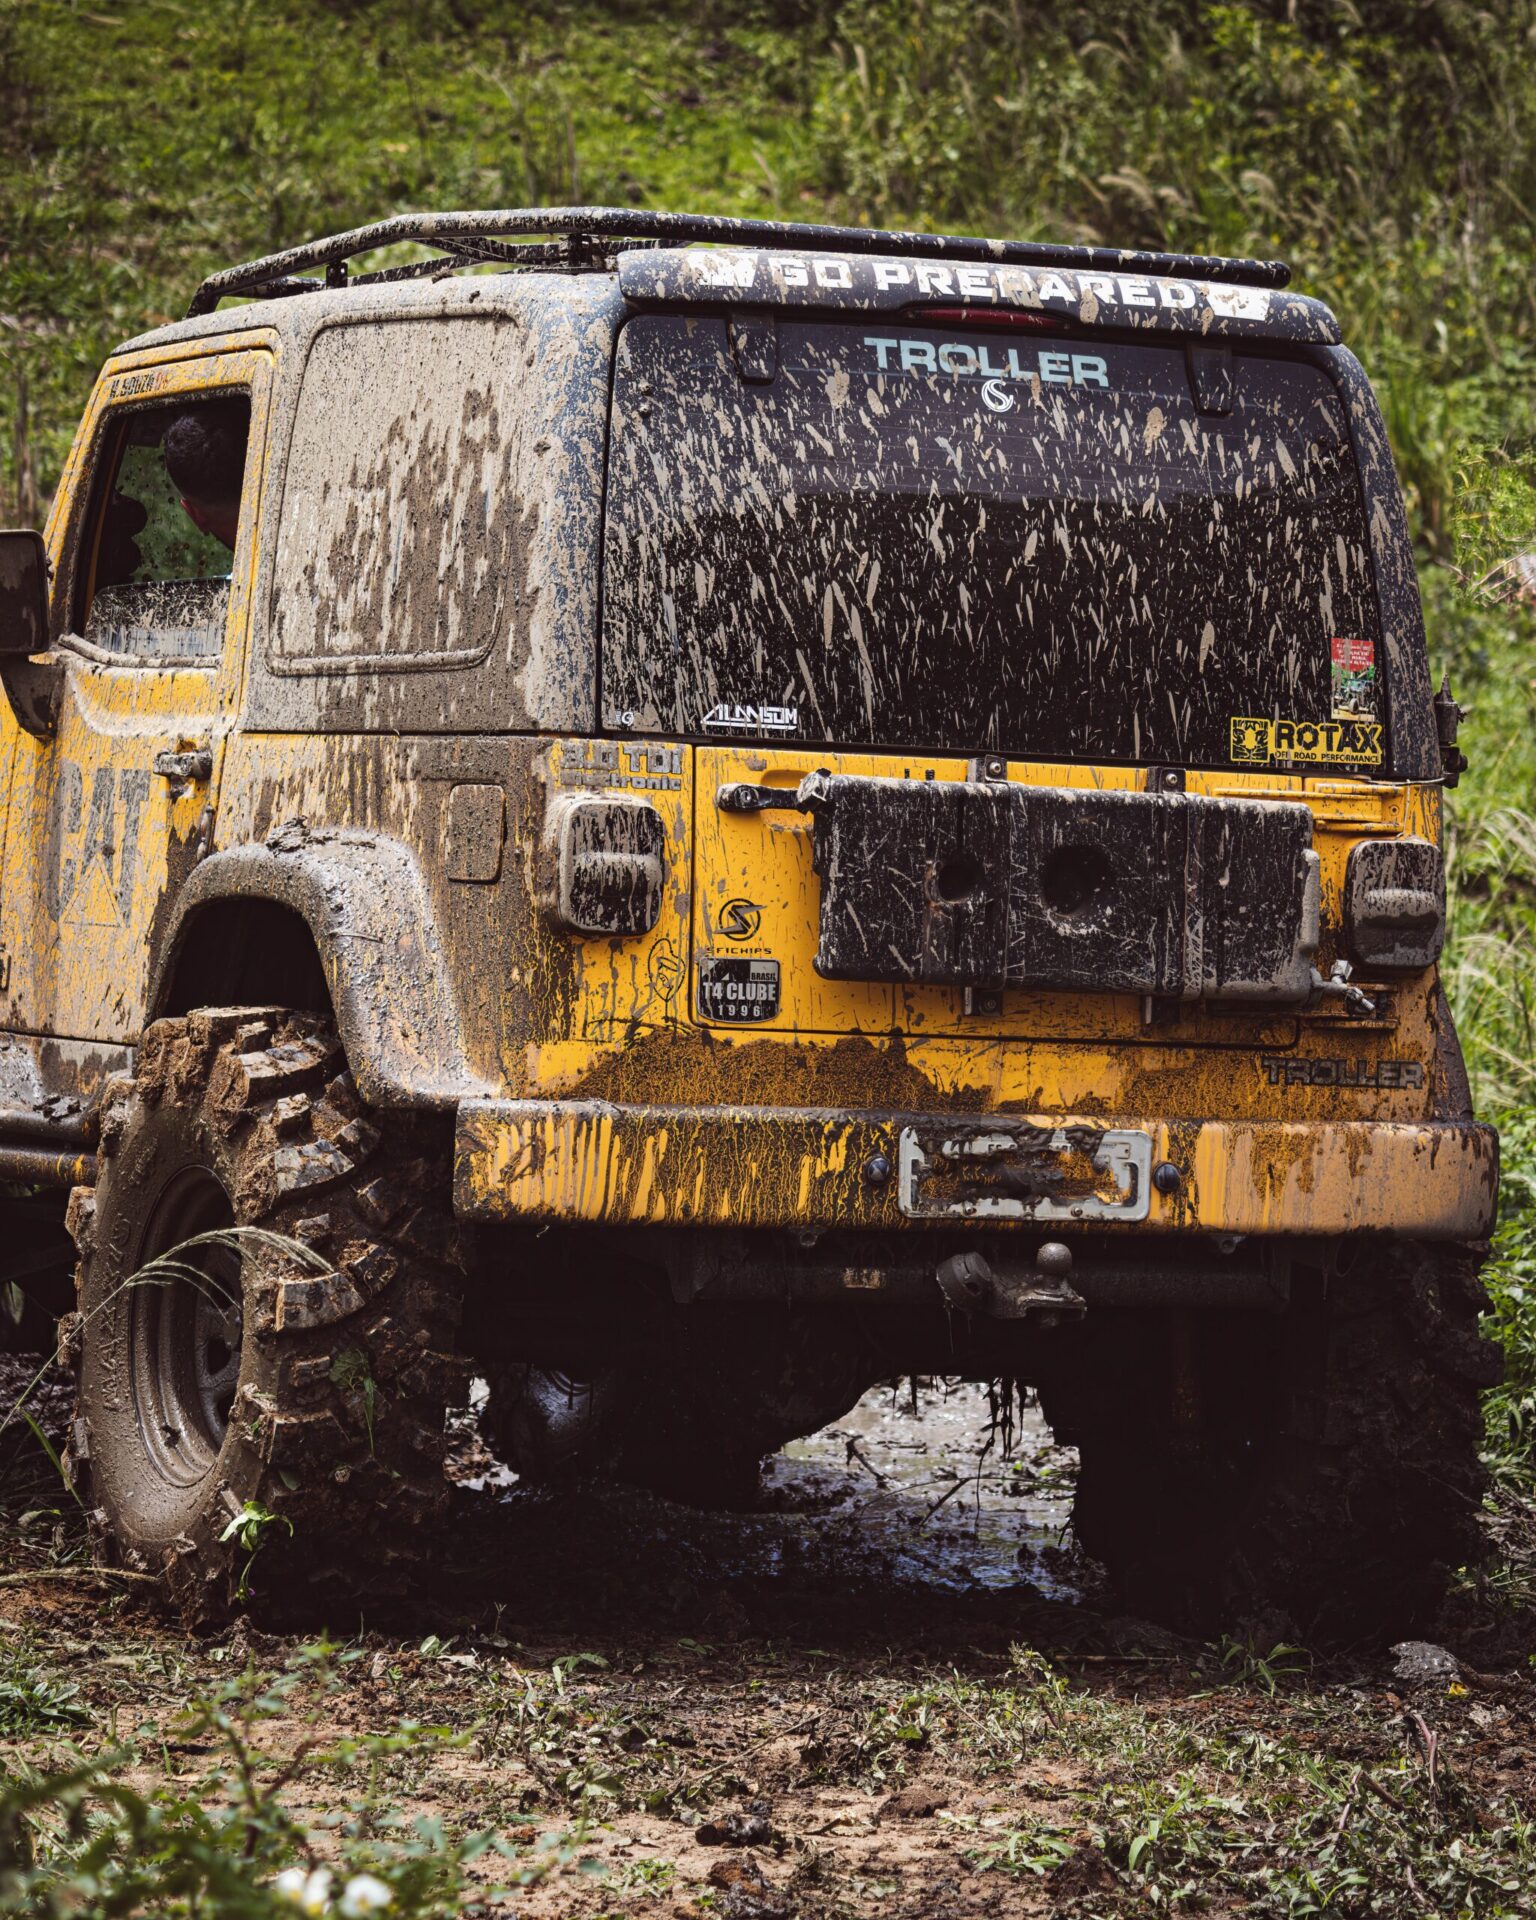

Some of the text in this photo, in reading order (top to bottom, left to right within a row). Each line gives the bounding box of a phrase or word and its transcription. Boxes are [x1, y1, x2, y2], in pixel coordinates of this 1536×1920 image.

[767, 257, 1198, 309] GO PREPARED
[863, 336, 1110, 388] TROLLER
[1275, 722, 1380, 754] ROTAX
[1294, 752, 1317, 760] ROAD
[1321, 754, 1379, 763] PERFORMANCE
[751, 972, 776, 981] BRASIL
[702, 982, 776, 1001] T4 CLUBE
[718, 1004, 760, 1017] 1996
[1261, 1056, 1424, 1090] TROLLER
